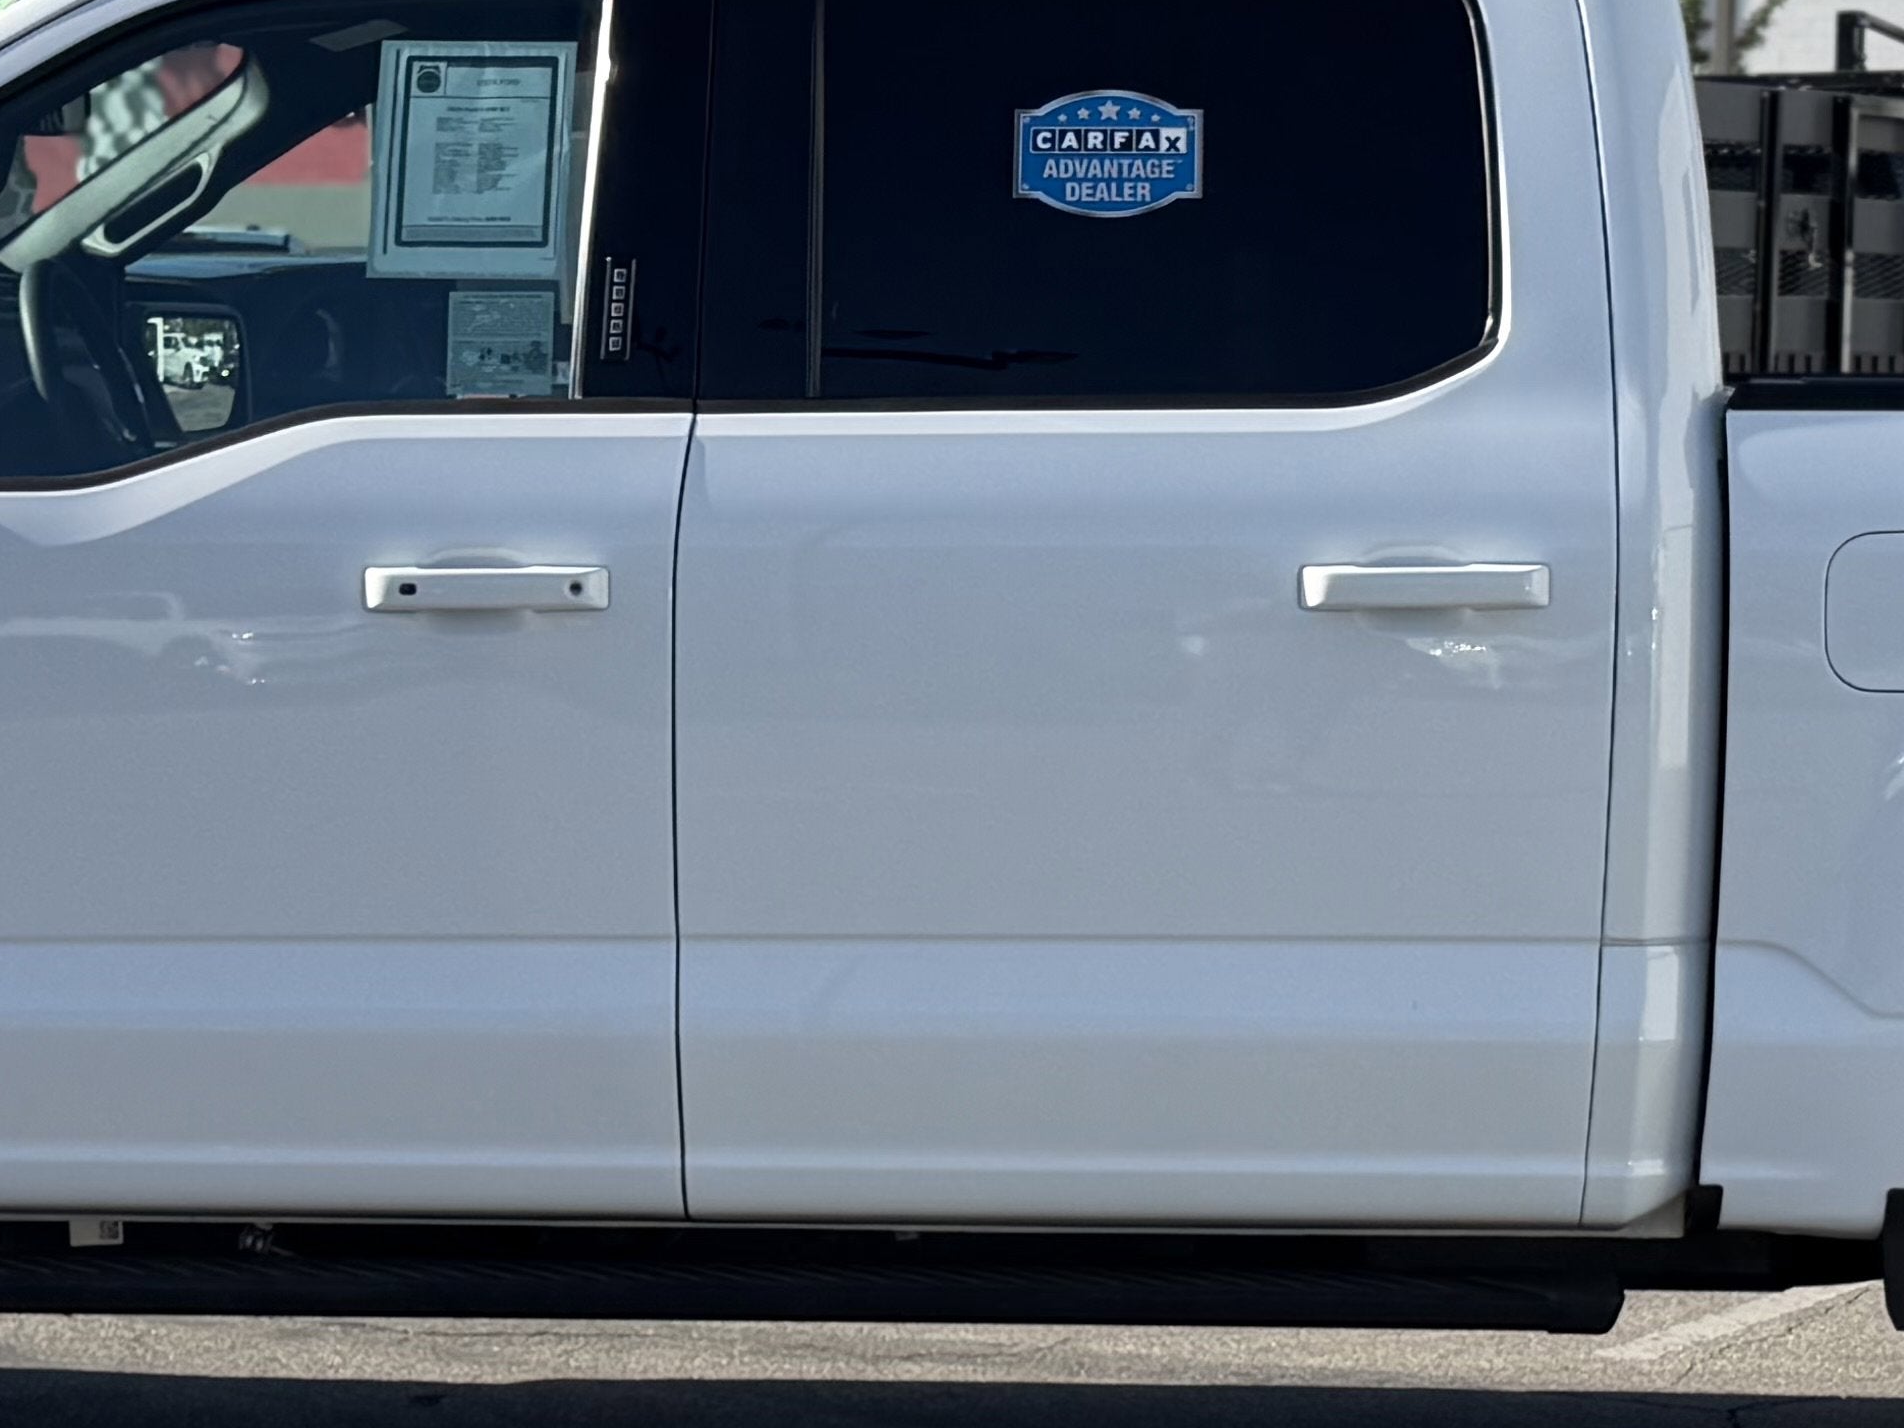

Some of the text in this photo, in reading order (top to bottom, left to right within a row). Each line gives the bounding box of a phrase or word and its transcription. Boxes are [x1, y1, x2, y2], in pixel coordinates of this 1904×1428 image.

[1033, 128, 1185, 152] CARFAX
[1042, 158, 1175, 179] ADVANTAGE
[1065, 181, 1152, 202] DEALER
